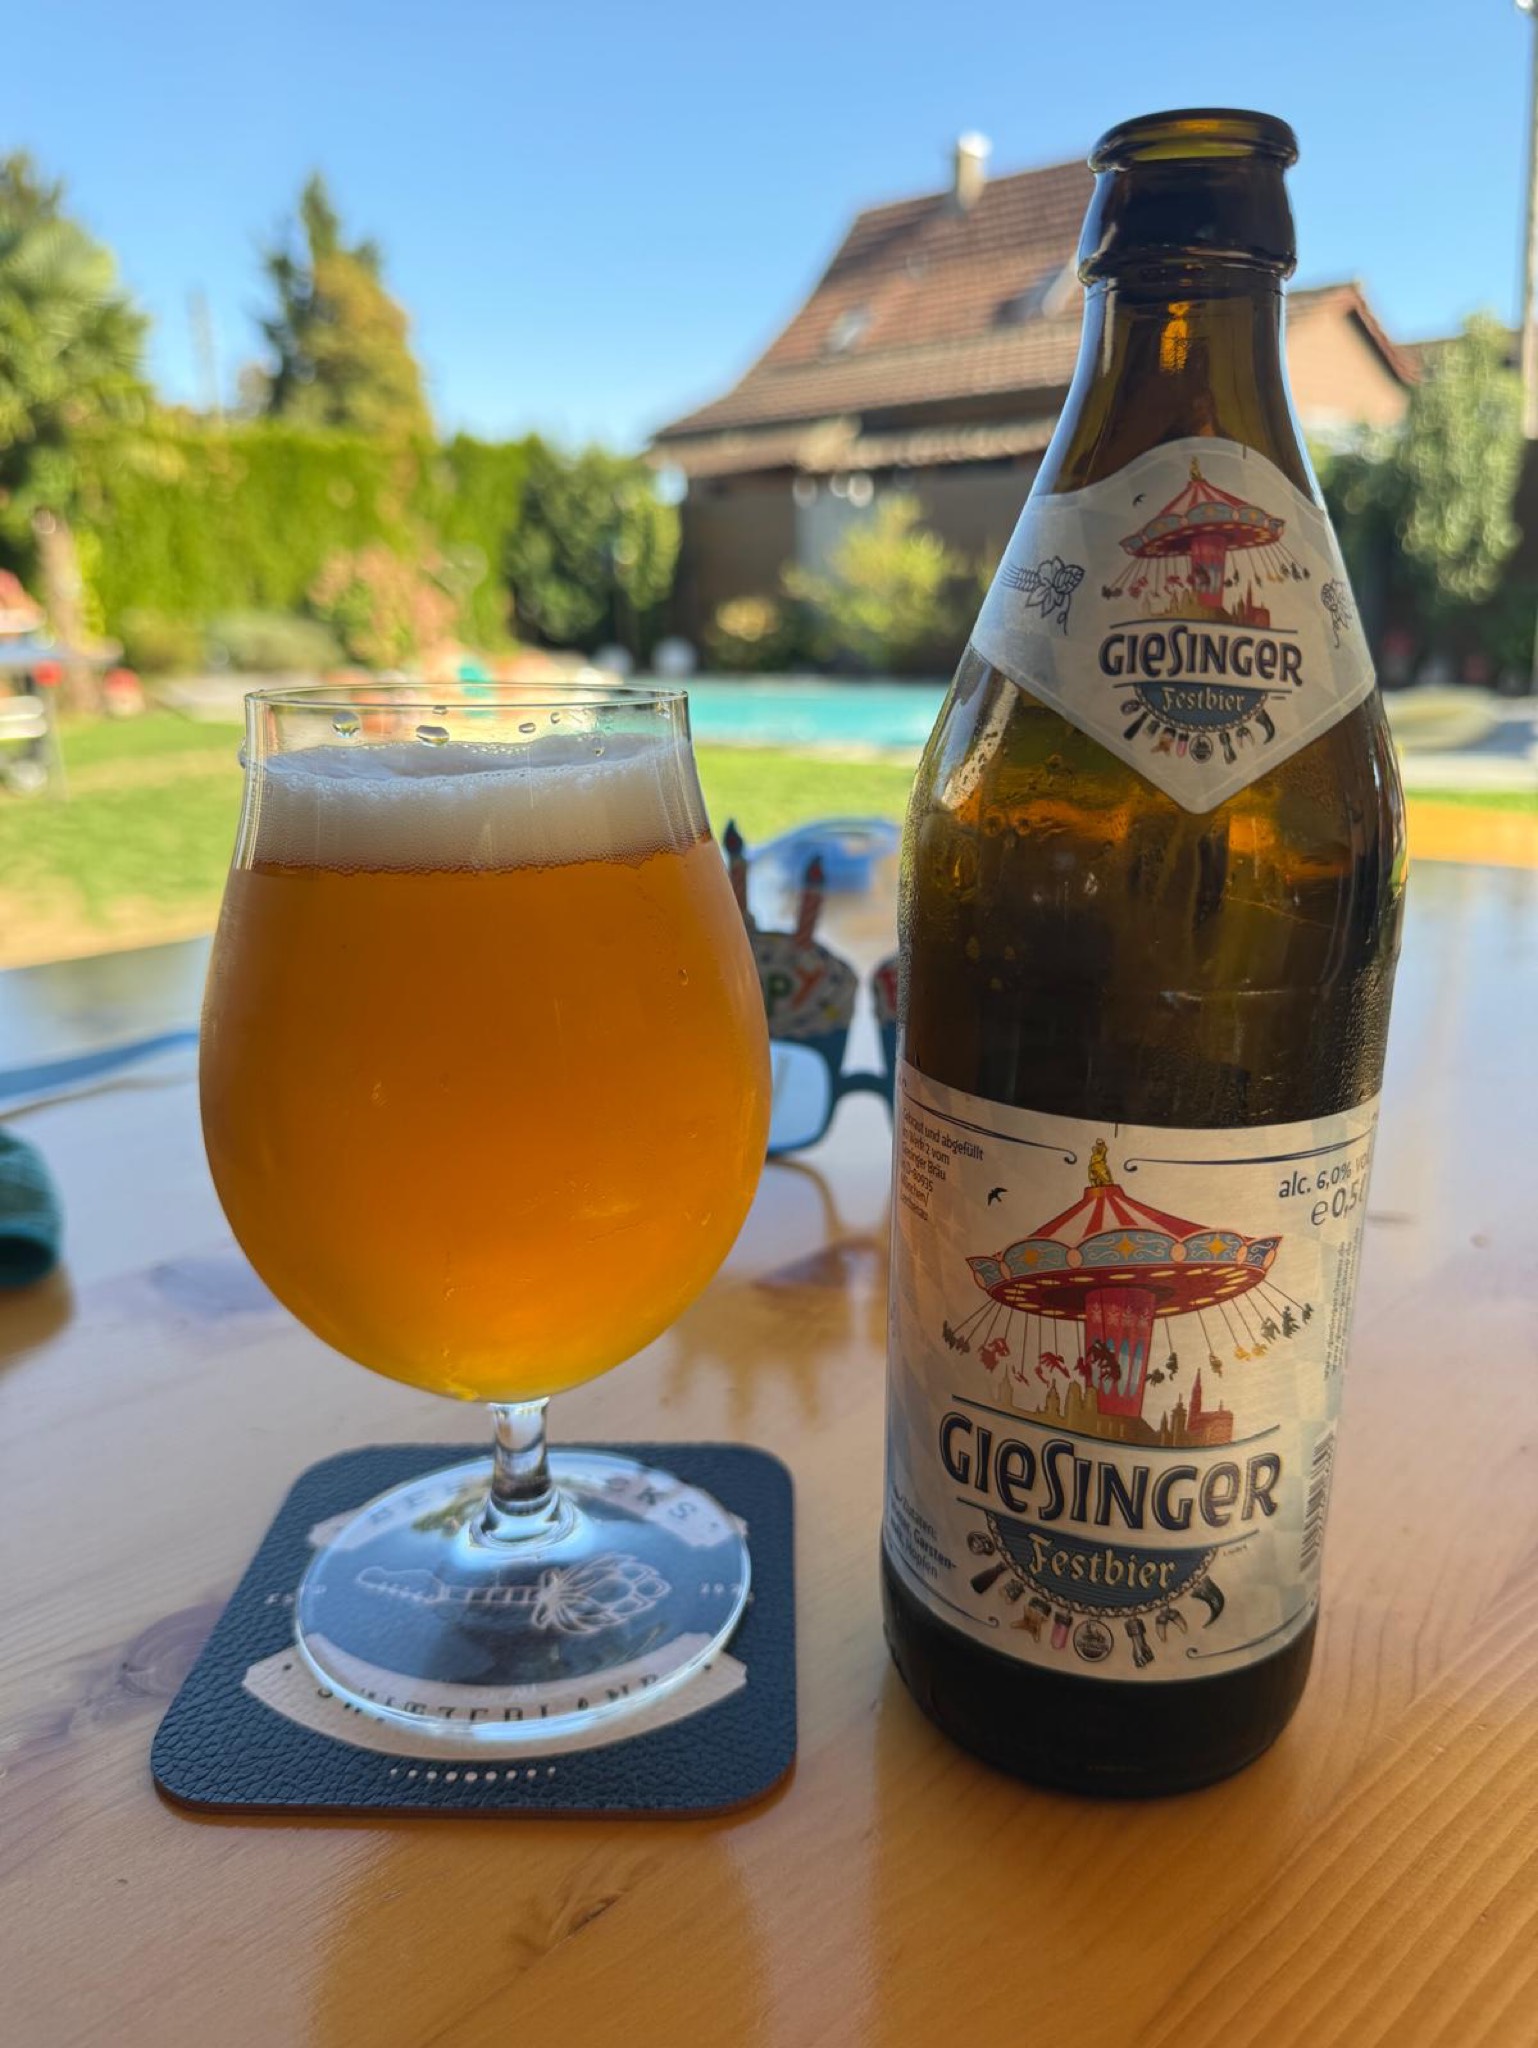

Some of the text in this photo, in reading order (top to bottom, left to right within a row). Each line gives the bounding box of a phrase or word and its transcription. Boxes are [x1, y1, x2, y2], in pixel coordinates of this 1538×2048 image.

[1161, 686, 1246, 712] Festbier
[925, 1125, 940, 1143] und
[942, 1132, 984, 1161] abgefüllt
[932, 1146, 950, 1166] vom
[1279, 1170, 1311, 1198] alc.
[1316, 1160, 1352, 1190] 6,0%
[1027, 1532, 1179, 1590] Festbier
